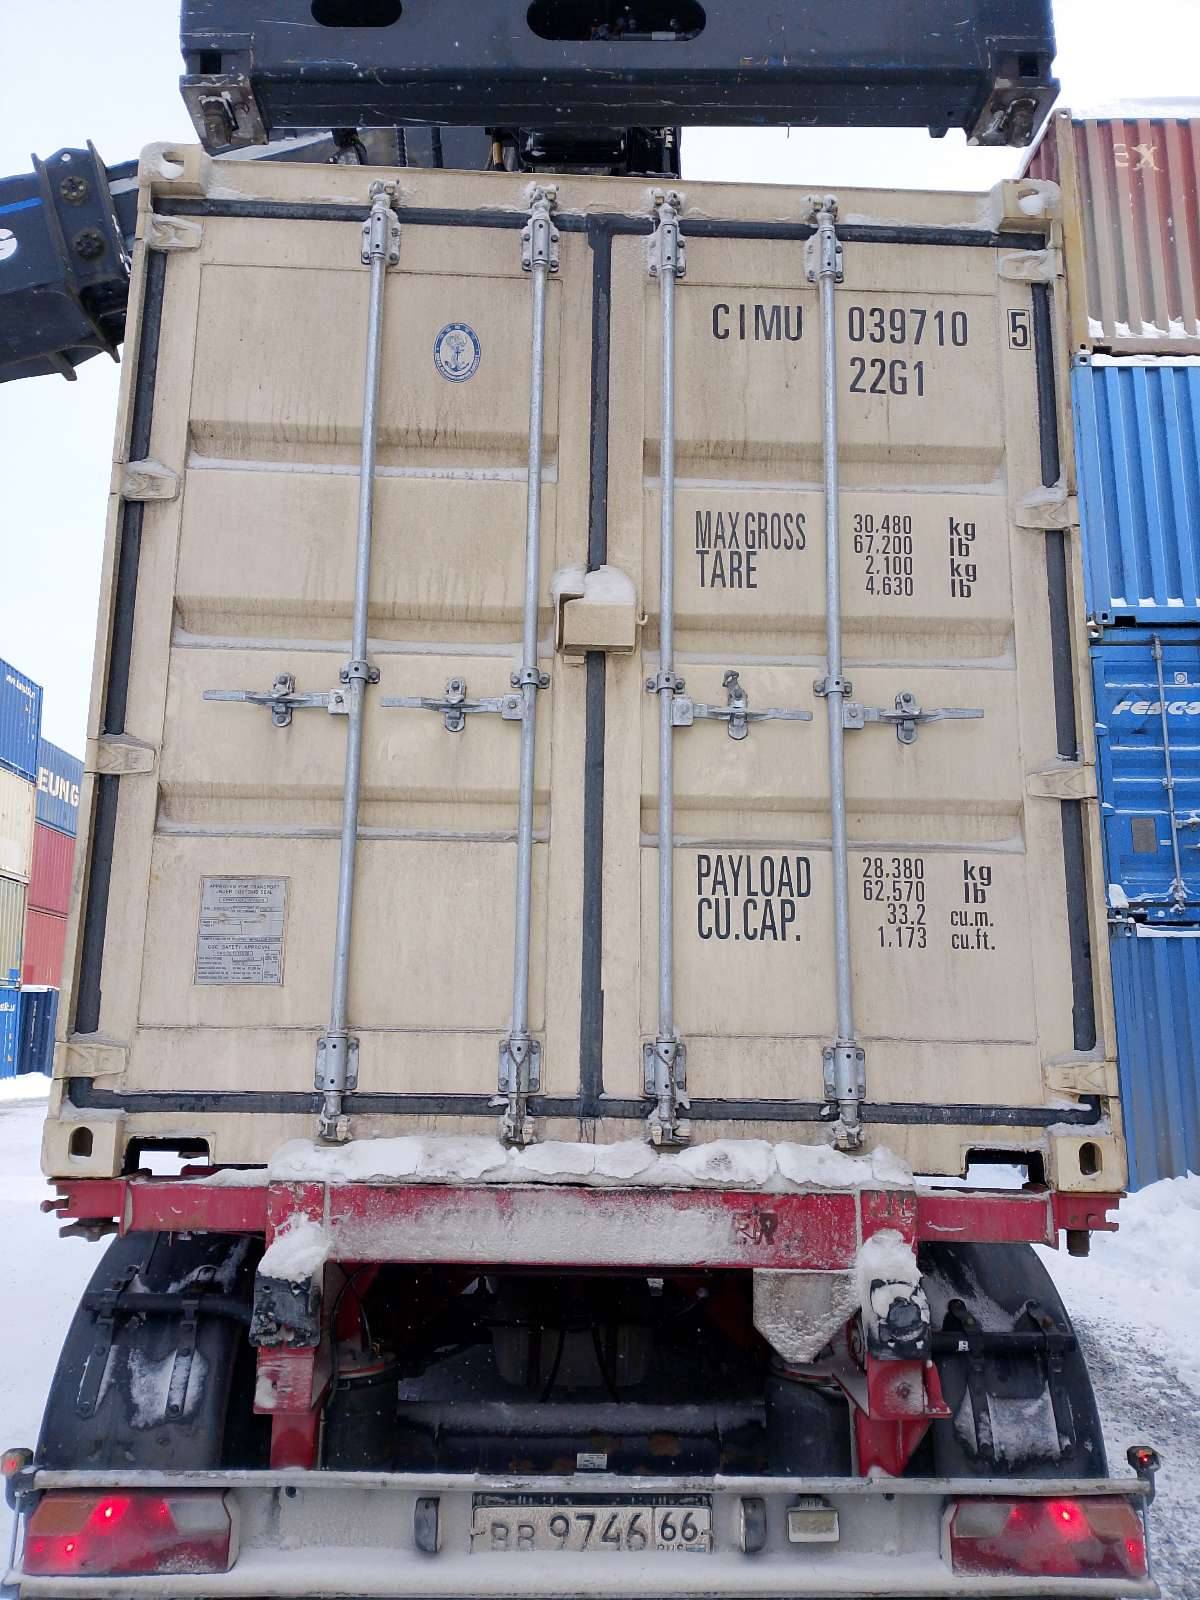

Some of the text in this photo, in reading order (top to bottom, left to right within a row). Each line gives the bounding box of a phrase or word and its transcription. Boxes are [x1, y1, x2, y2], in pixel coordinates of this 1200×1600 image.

[712, 304, 1029, 347] CIMU 039710 5
[849, 357, 924, 396] 22G1
[695, 510, 806, 550] MAX GROSS
[949, 517, 976, 541] kg
[950, 538, 970, 556] lb
[696, 550, 758, 589] TARE
[950, 558, 977, 582] kg
[951, 579, 972, 598] lb
[38, 766, 80, 808] EUNG
[697, 854, 811, 898] PAYLOAD
[963, 860, 992, 886] kg
[964, 883, 986, 904] lb
[698, 898, 800, 941] CU.CAP.
[887, 903, 994, 927] 33.2 cu.m.
[951, 929, 996, 950] cu.ft.
[549, 1513, 648, 1550] 9746
[660, 1511, 698, 1542] 66
